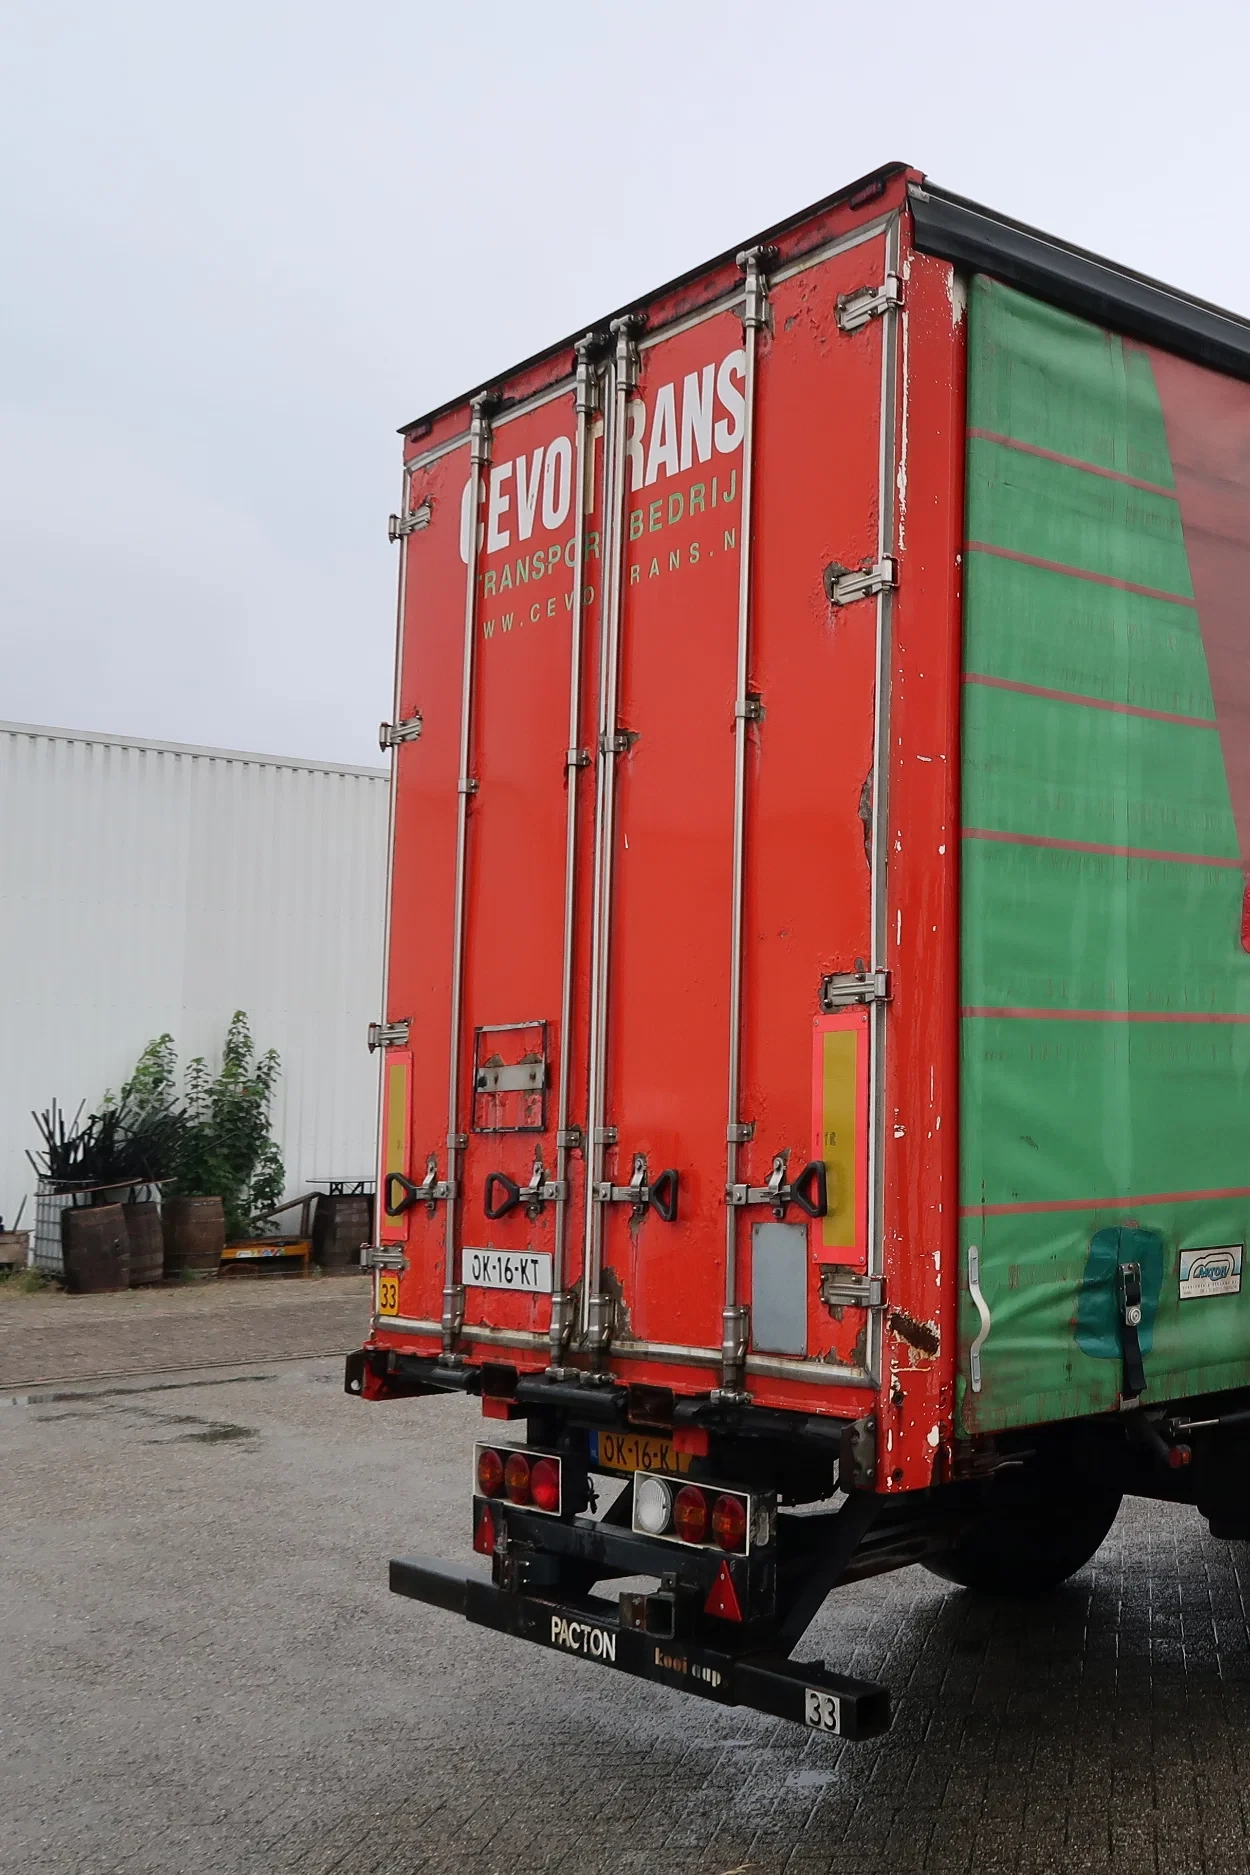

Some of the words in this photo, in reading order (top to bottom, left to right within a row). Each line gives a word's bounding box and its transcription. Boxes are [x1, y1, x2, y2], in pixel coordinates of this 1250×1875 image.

[460, 349, 745, 564] CEVOTRANS
[471, 1254, 539, 1286] OK-16-KT
[381, 1283, 397, 1309] 33
[551, 1615, 616, 1662] PACTON
[654, 1647, 688, 1674] kooi
[809, 1692, 837, 1731] 33
